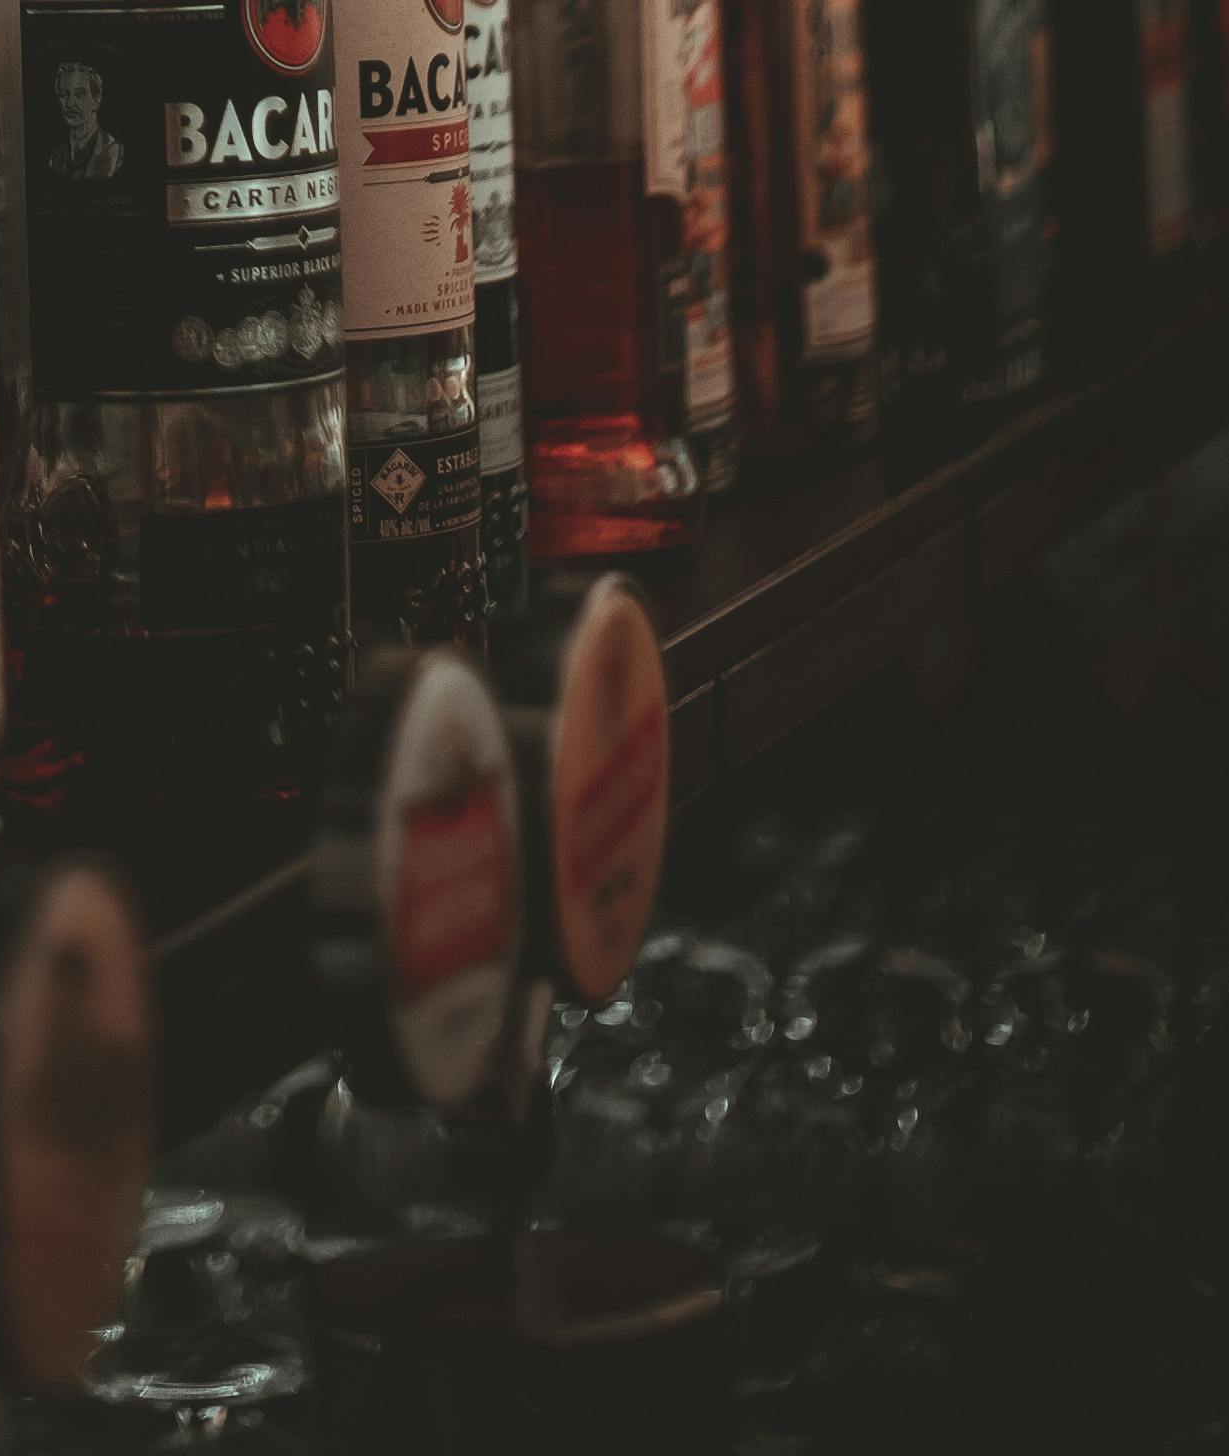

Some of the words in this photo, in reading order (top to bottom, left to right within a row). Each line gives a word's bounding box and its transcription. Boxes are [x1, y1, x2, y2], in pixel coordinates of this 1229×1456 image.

[203, 184, 298, 211] CARTA
[230, 262, 301, 282] SUPERIOR
[396, 301, 428, 316] MADE
[351, 467, 363, 524] SPICED
